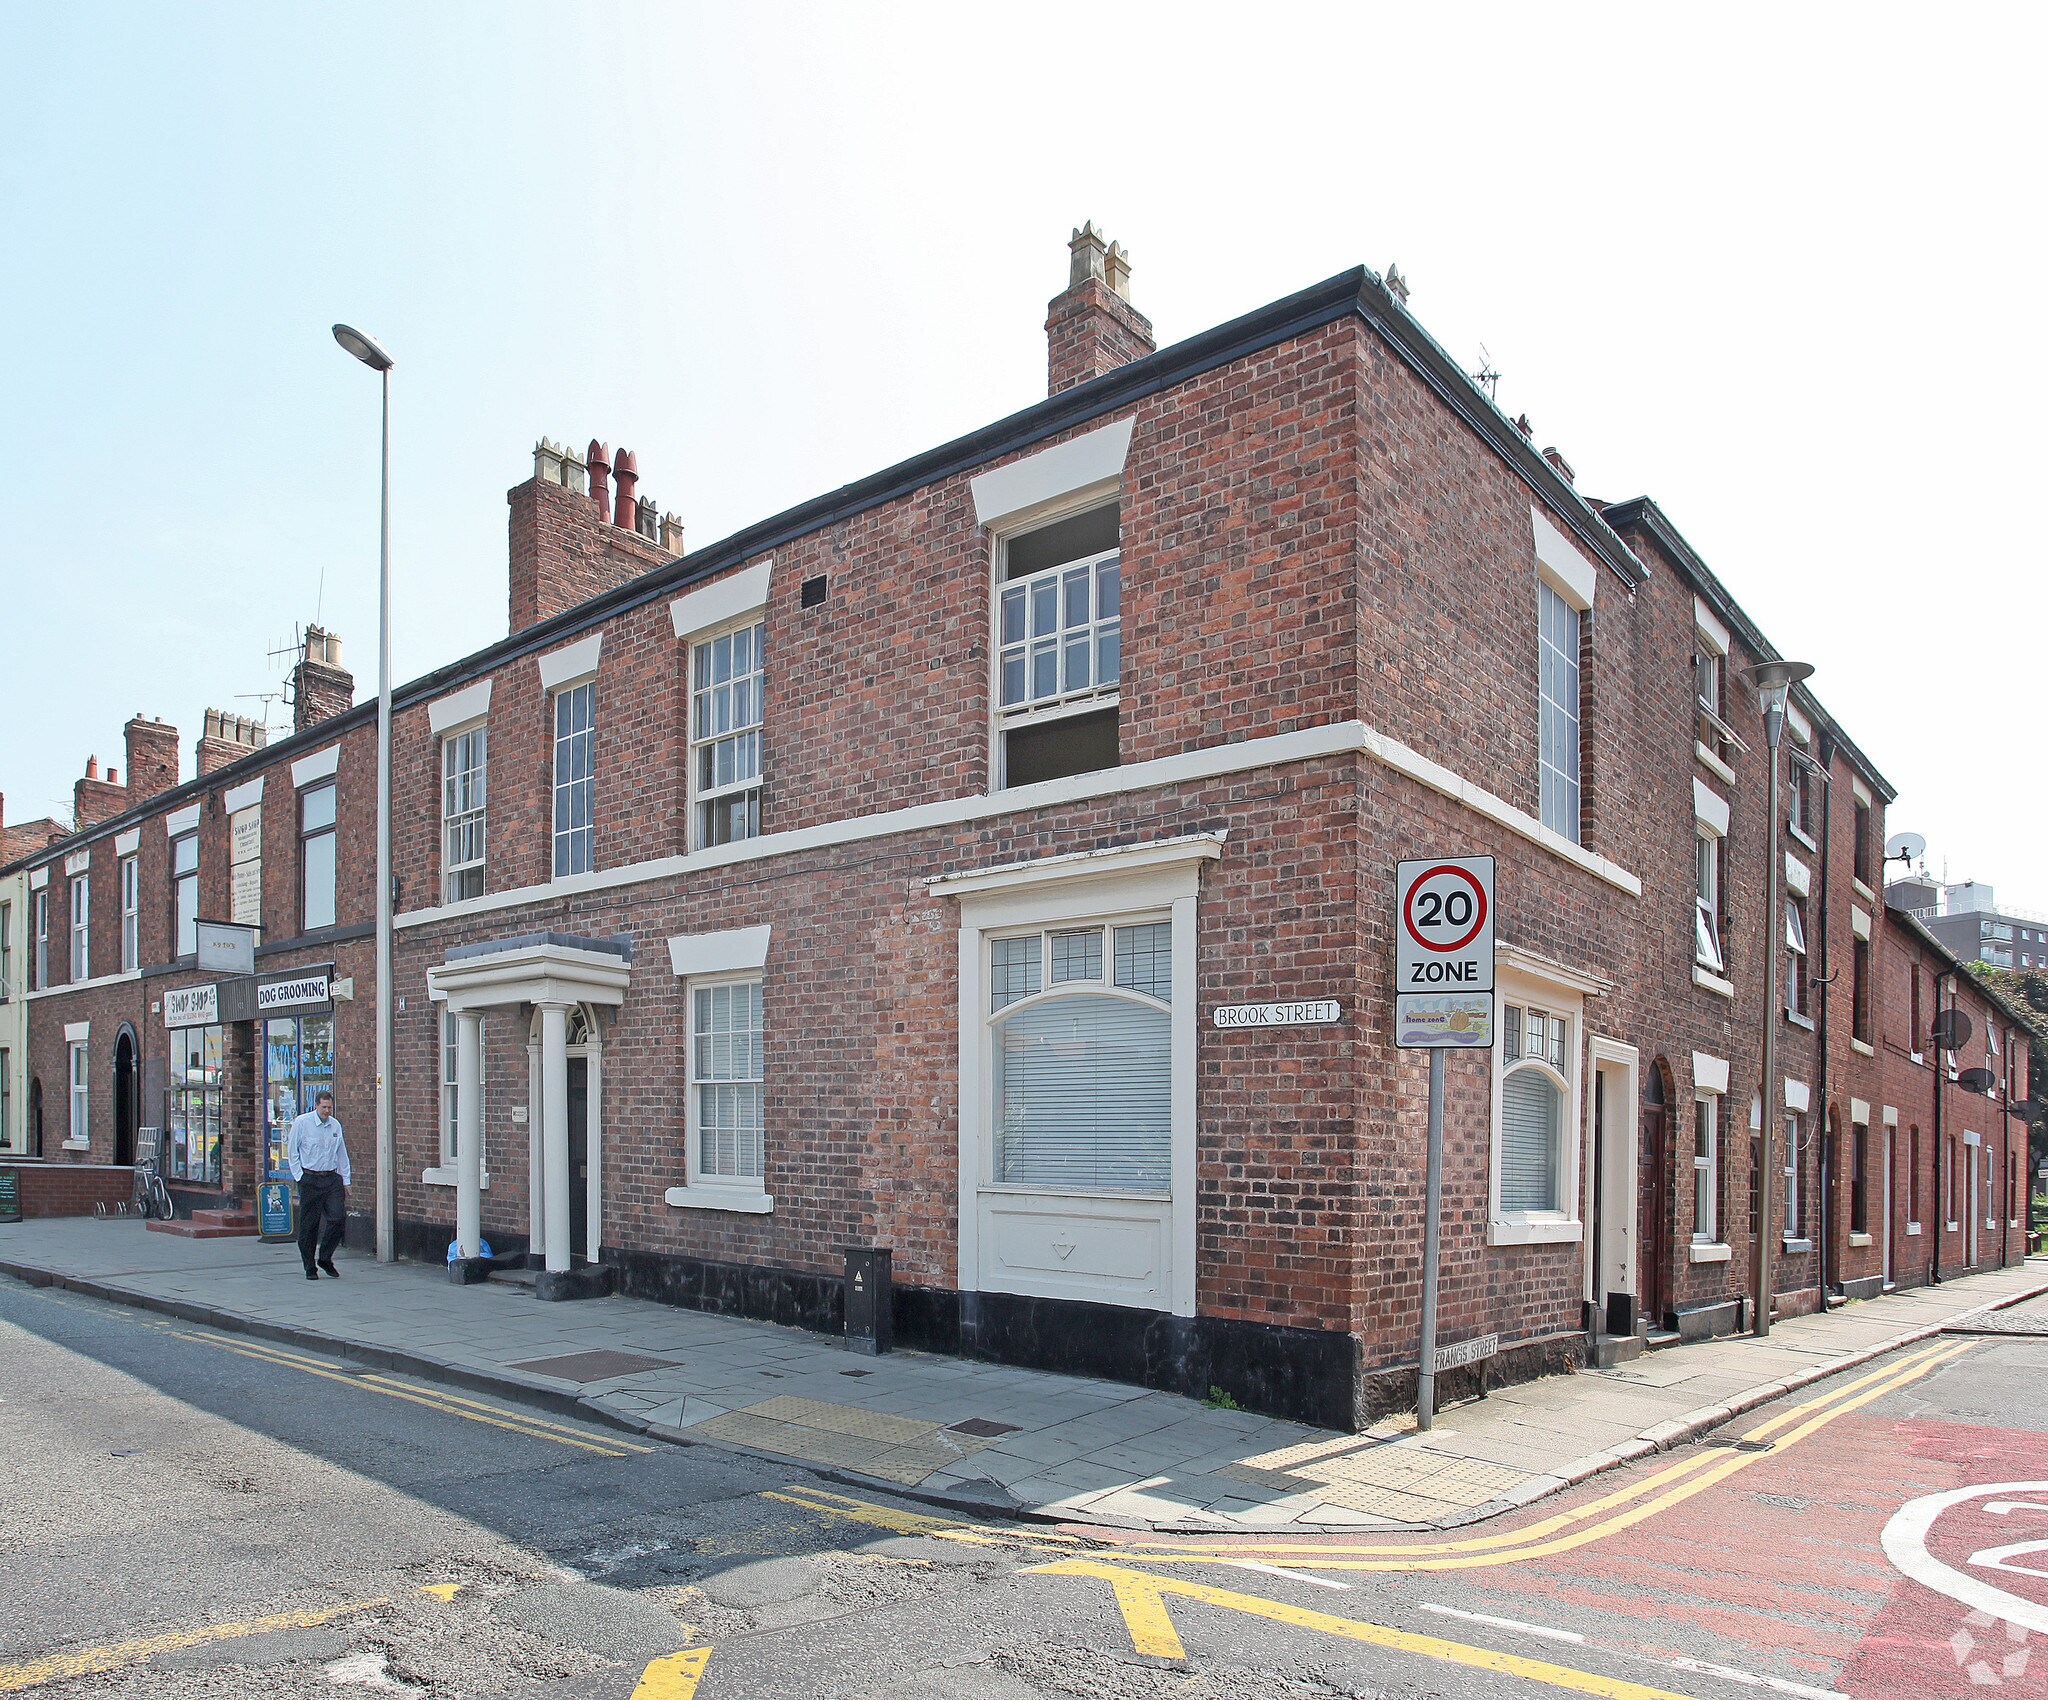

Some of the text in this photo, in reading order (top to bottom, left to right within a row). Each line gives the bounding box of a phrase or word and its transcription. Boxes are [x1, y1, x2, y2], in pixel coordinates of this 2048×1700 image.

[1417, 891, 1473, 927] 20
[1411, 960, 1478, 983] ZONE
[259, 988, 277, 1005] DOG
[278, 981, 325, 1000] GROOMING
[1219, 1002, 1334, 1025] BROOK STREET
[1406, 1015, 1426, 1023] home
[1435, 1337, 1497, 1370] FRANCIS STREET
